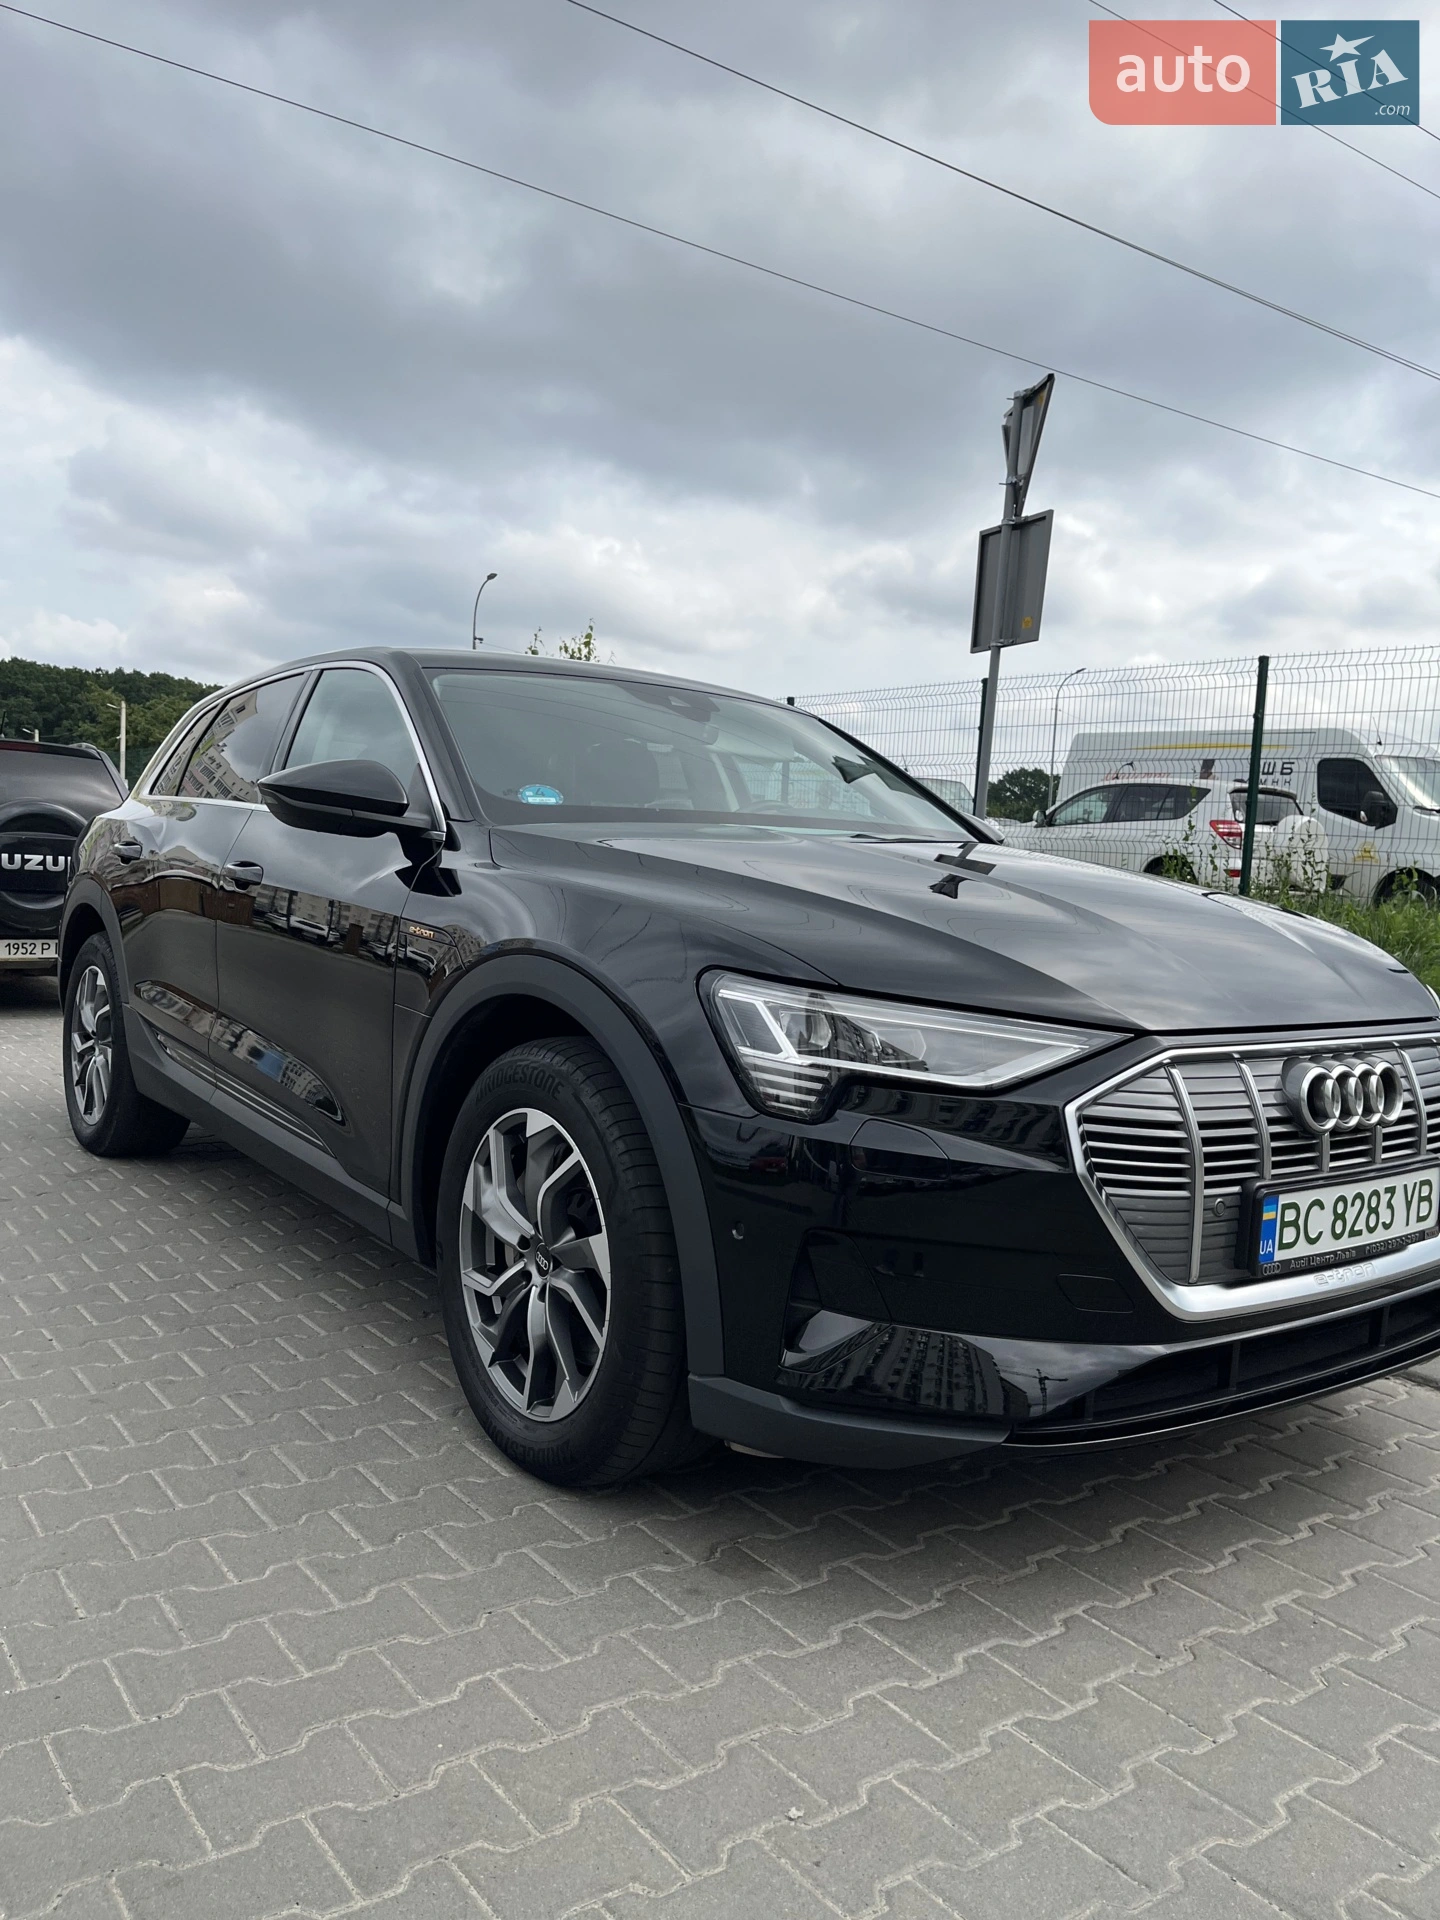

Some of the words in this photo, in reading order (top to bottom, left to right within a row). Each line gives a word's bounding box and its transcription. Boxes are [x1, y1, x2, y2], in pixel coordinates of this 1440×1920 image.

[1, 853, 71, 872] UZU
[5, 942, 37, 955] 1952
[1278, 1198, 1326, 1251] BC
[1330, 1185, 1397, 1241] 8283
[1403, 1178, 1433, 1227] YB
[1259, 1239, 1273, 1255] UA
[1290, 1257, 1308, 1270] Audi
[1313, 1263, 1375, 1286] e-tron
